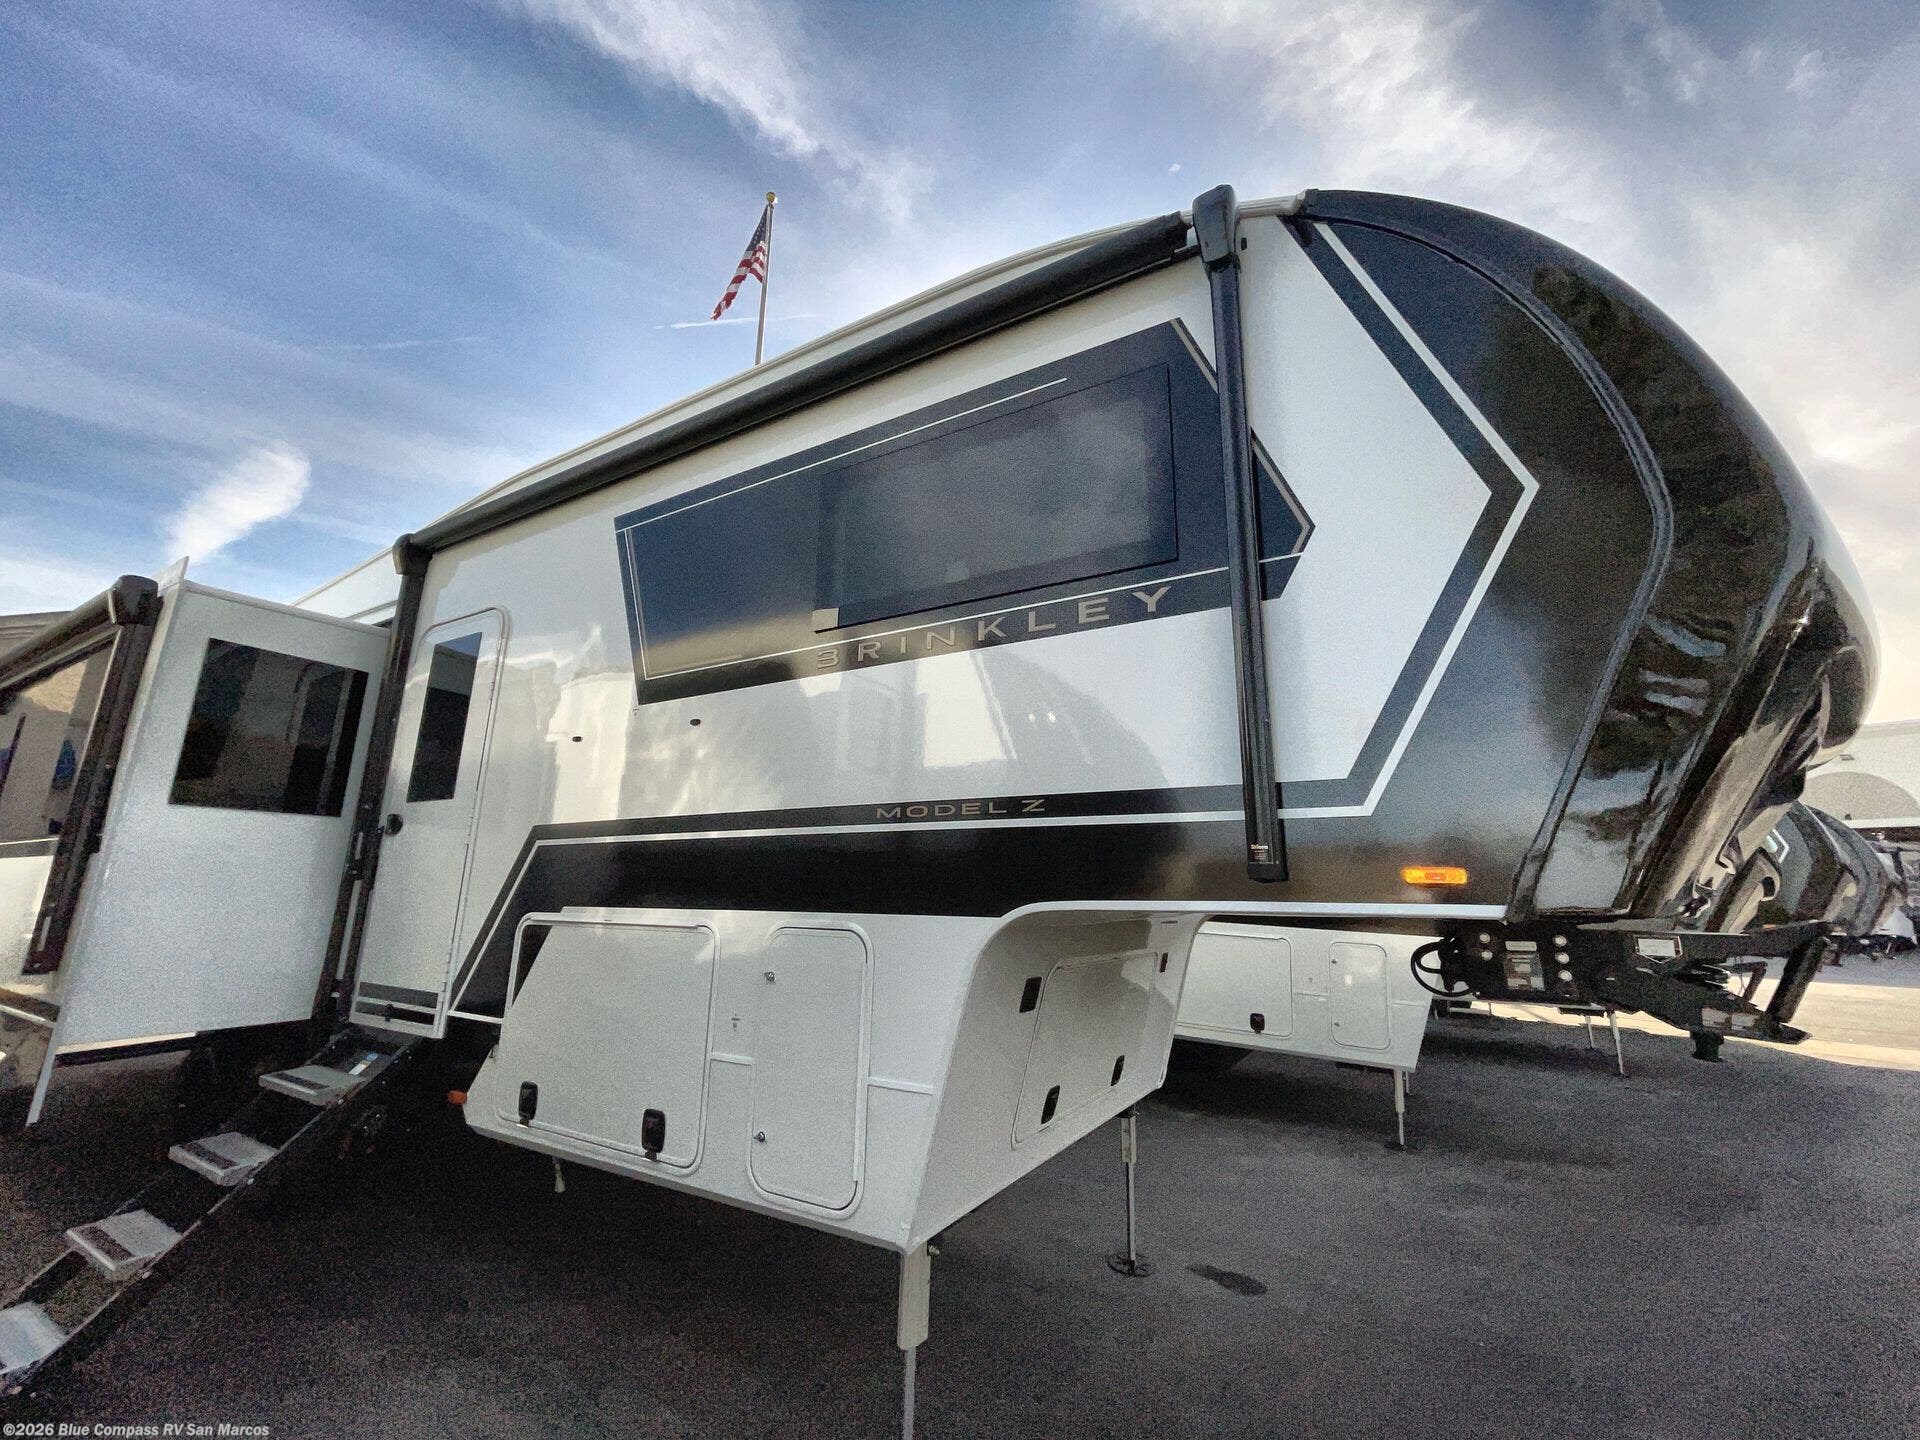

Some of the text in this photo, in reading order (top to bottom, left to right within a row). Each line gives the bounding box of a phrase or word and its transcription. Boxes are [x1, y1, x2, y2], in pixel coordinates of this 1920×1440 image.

[817, 586, 1171, 669] BRINKLEY
[876, 799, 1045, 819] MODEL Z
